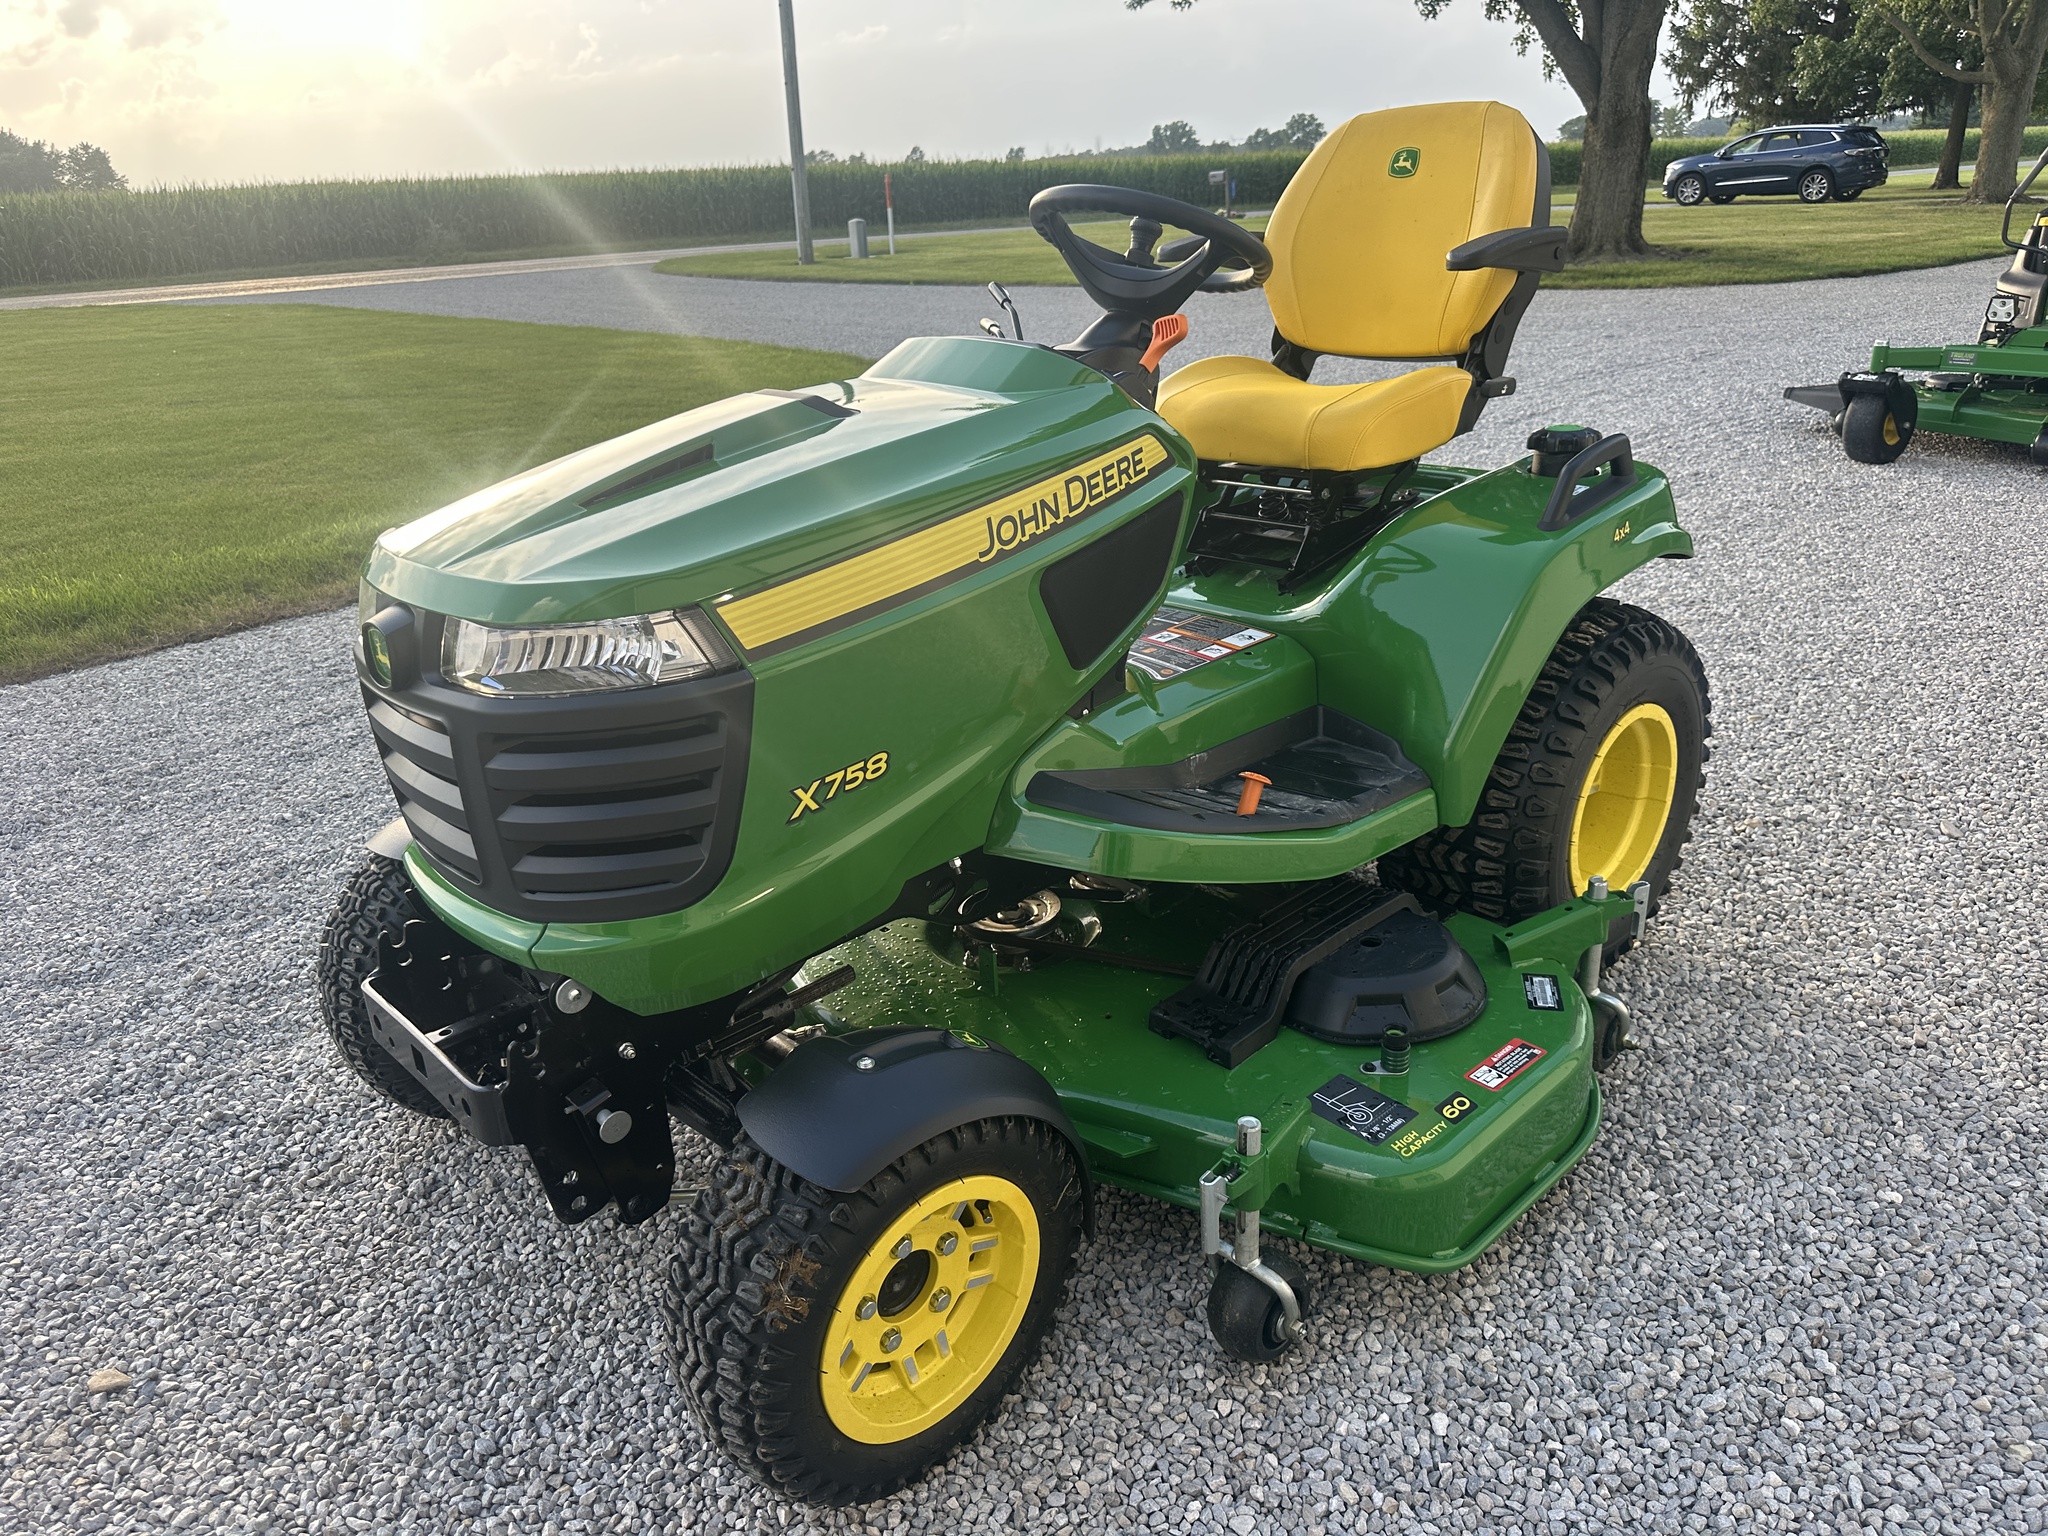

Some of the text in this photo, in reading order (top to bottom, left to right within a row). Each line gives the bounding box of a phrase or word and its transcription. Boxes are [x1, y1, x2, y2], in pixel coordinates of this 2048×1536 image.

[978, 446, 1147, 561] JOHN DEERE
[1613, 520, 1631, 542] 4x4
[786, 751, 890, 825] X758
[1494, 1044, 1514, 1058] DANGER
[1442, 1096, 1471, 1119] 60
[1390, 1130, 1419, 1151] HIGH
[1400, 1120, 1448, 1157] CAPACITY
